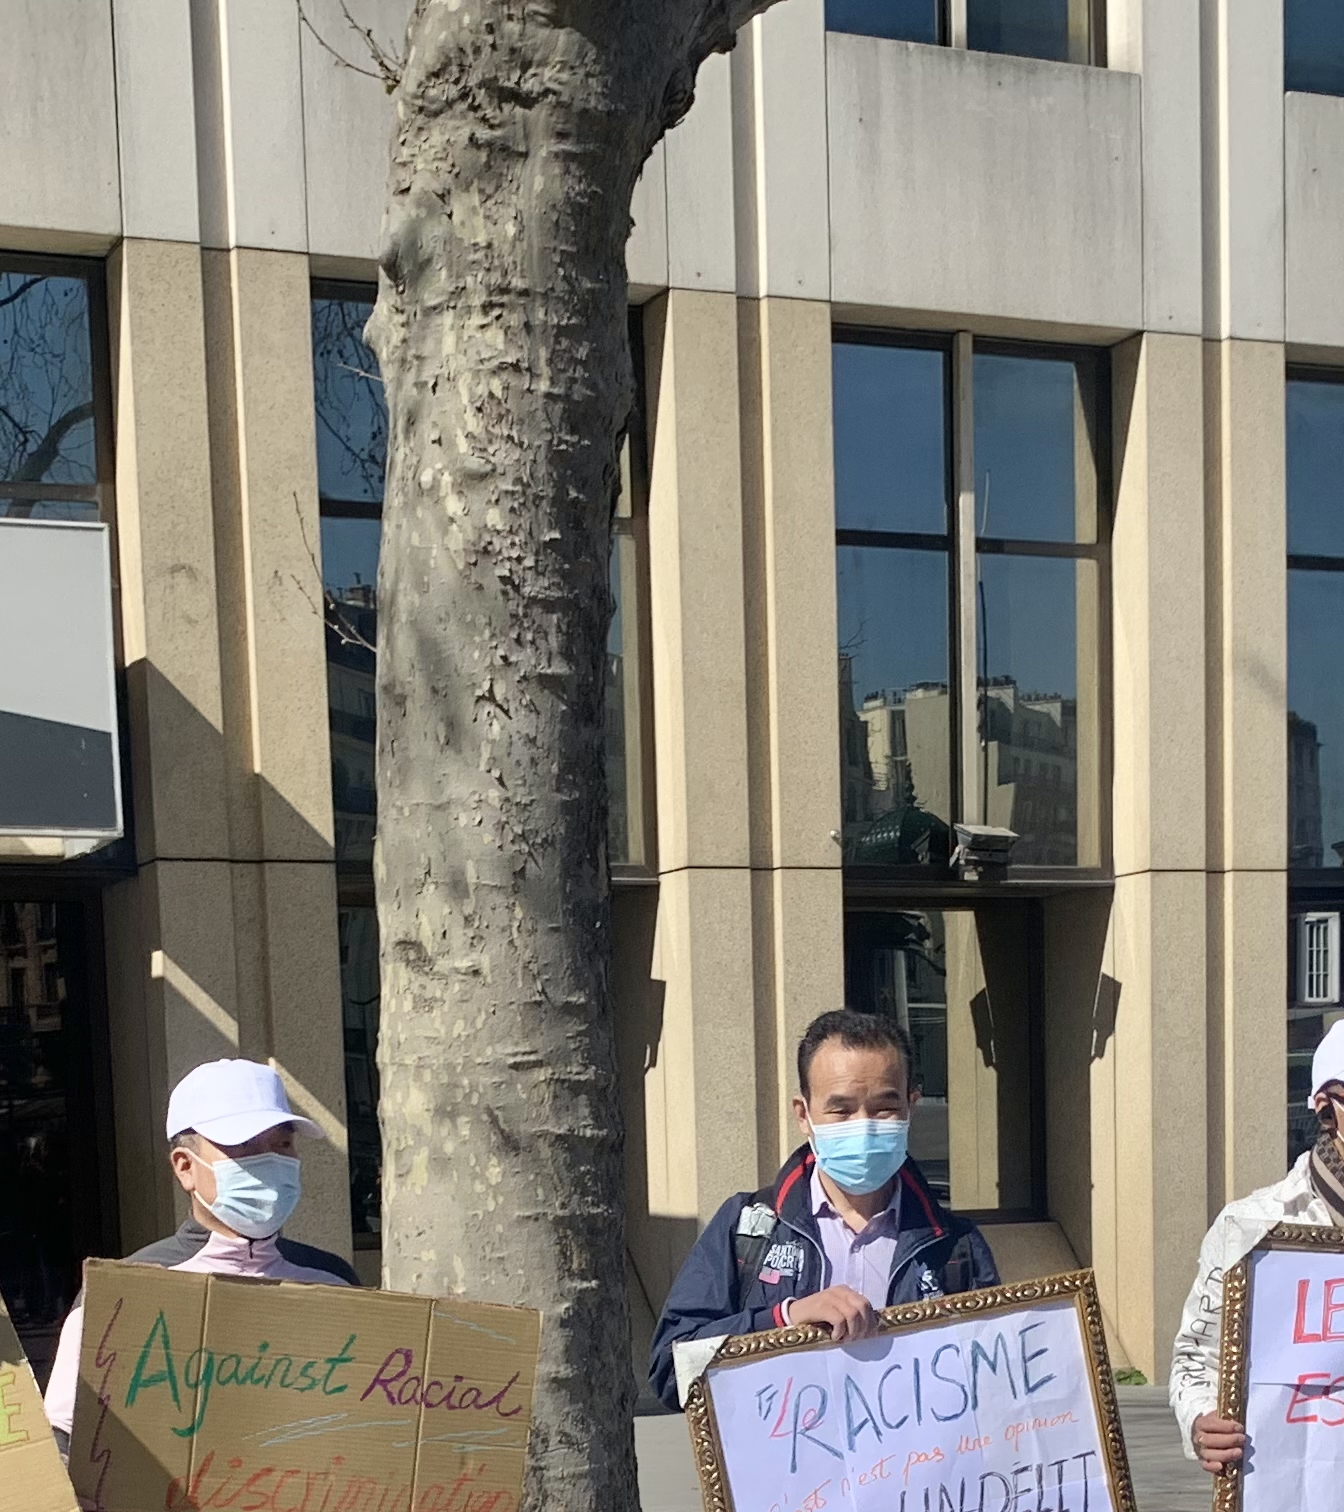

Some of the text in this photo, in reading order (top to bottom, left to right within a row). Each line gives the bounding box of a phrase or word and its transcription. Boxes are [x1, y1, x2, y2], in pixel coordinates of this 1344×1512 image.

[125, 1308, 524, 1438] Against Racial
[790, 1321, 1057, 1474] RACISME
[902, 1446, 946, 1487] pas
